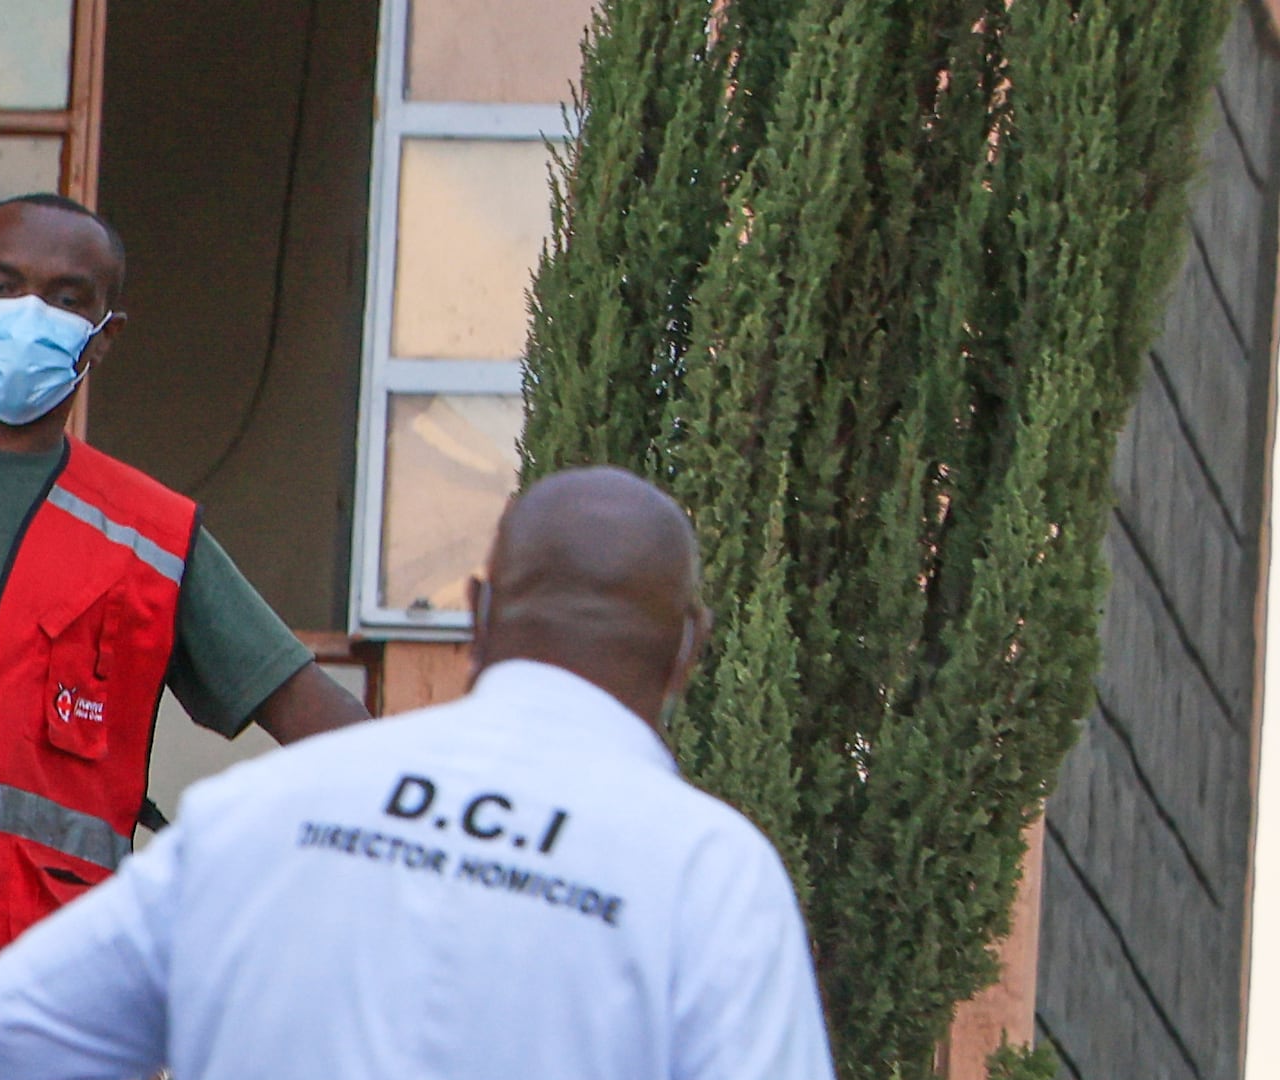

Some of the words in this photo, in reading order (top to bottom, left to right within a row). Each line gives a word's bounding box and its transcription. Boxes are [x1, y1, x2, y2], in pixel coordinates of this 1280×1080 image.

[384, 774, 569, 854] D.C.I
[298, 822, 447, 876] DIRECTOR
[457, 857, 623, 927] HOMICIDE
